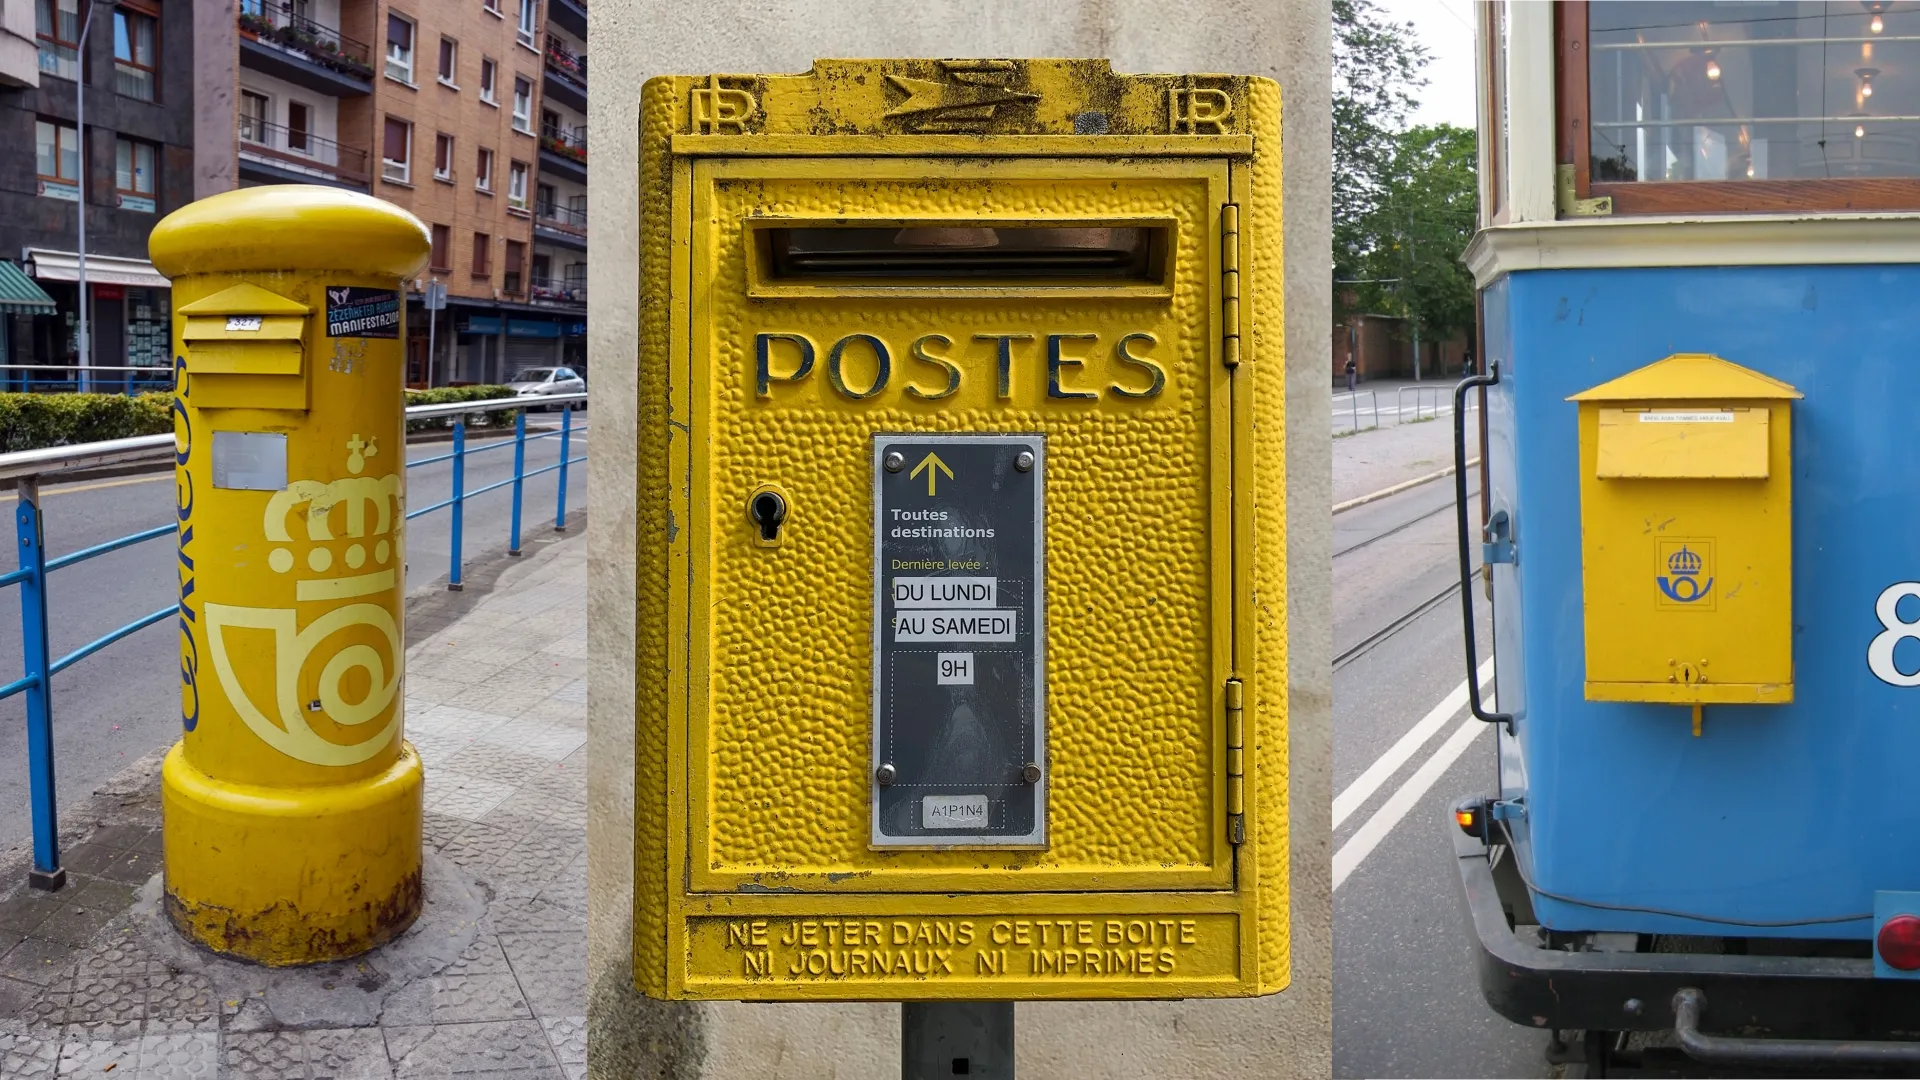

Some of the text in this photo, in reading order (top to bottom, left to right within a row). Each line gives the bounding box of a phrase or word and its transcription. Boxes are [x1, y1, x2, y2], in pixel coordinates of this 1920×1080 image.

[755, 332, 1168, 400] POSTES
[890, 508, 949, 521] Toutes
[890, 525, 995, 538] destinations
[892, 558, 945, 570] Dernière
[948, 558, 981, 570] levée
[895, 584, 924, 601] DU
[931, 584, 991, 601] LUNDI
[897, 617, 925, 635] AU
[932, 617, 1010, 635] SAMEDI
[941, 659, 967, 678] 9H
[931, 804, 984, 817] A1P1N4
[729, 919, 1197, 946] NE JETER DANS CETTE BOITE
[744, 948, 1177, 975] NI JOURNAUX NI IMPRIMES
